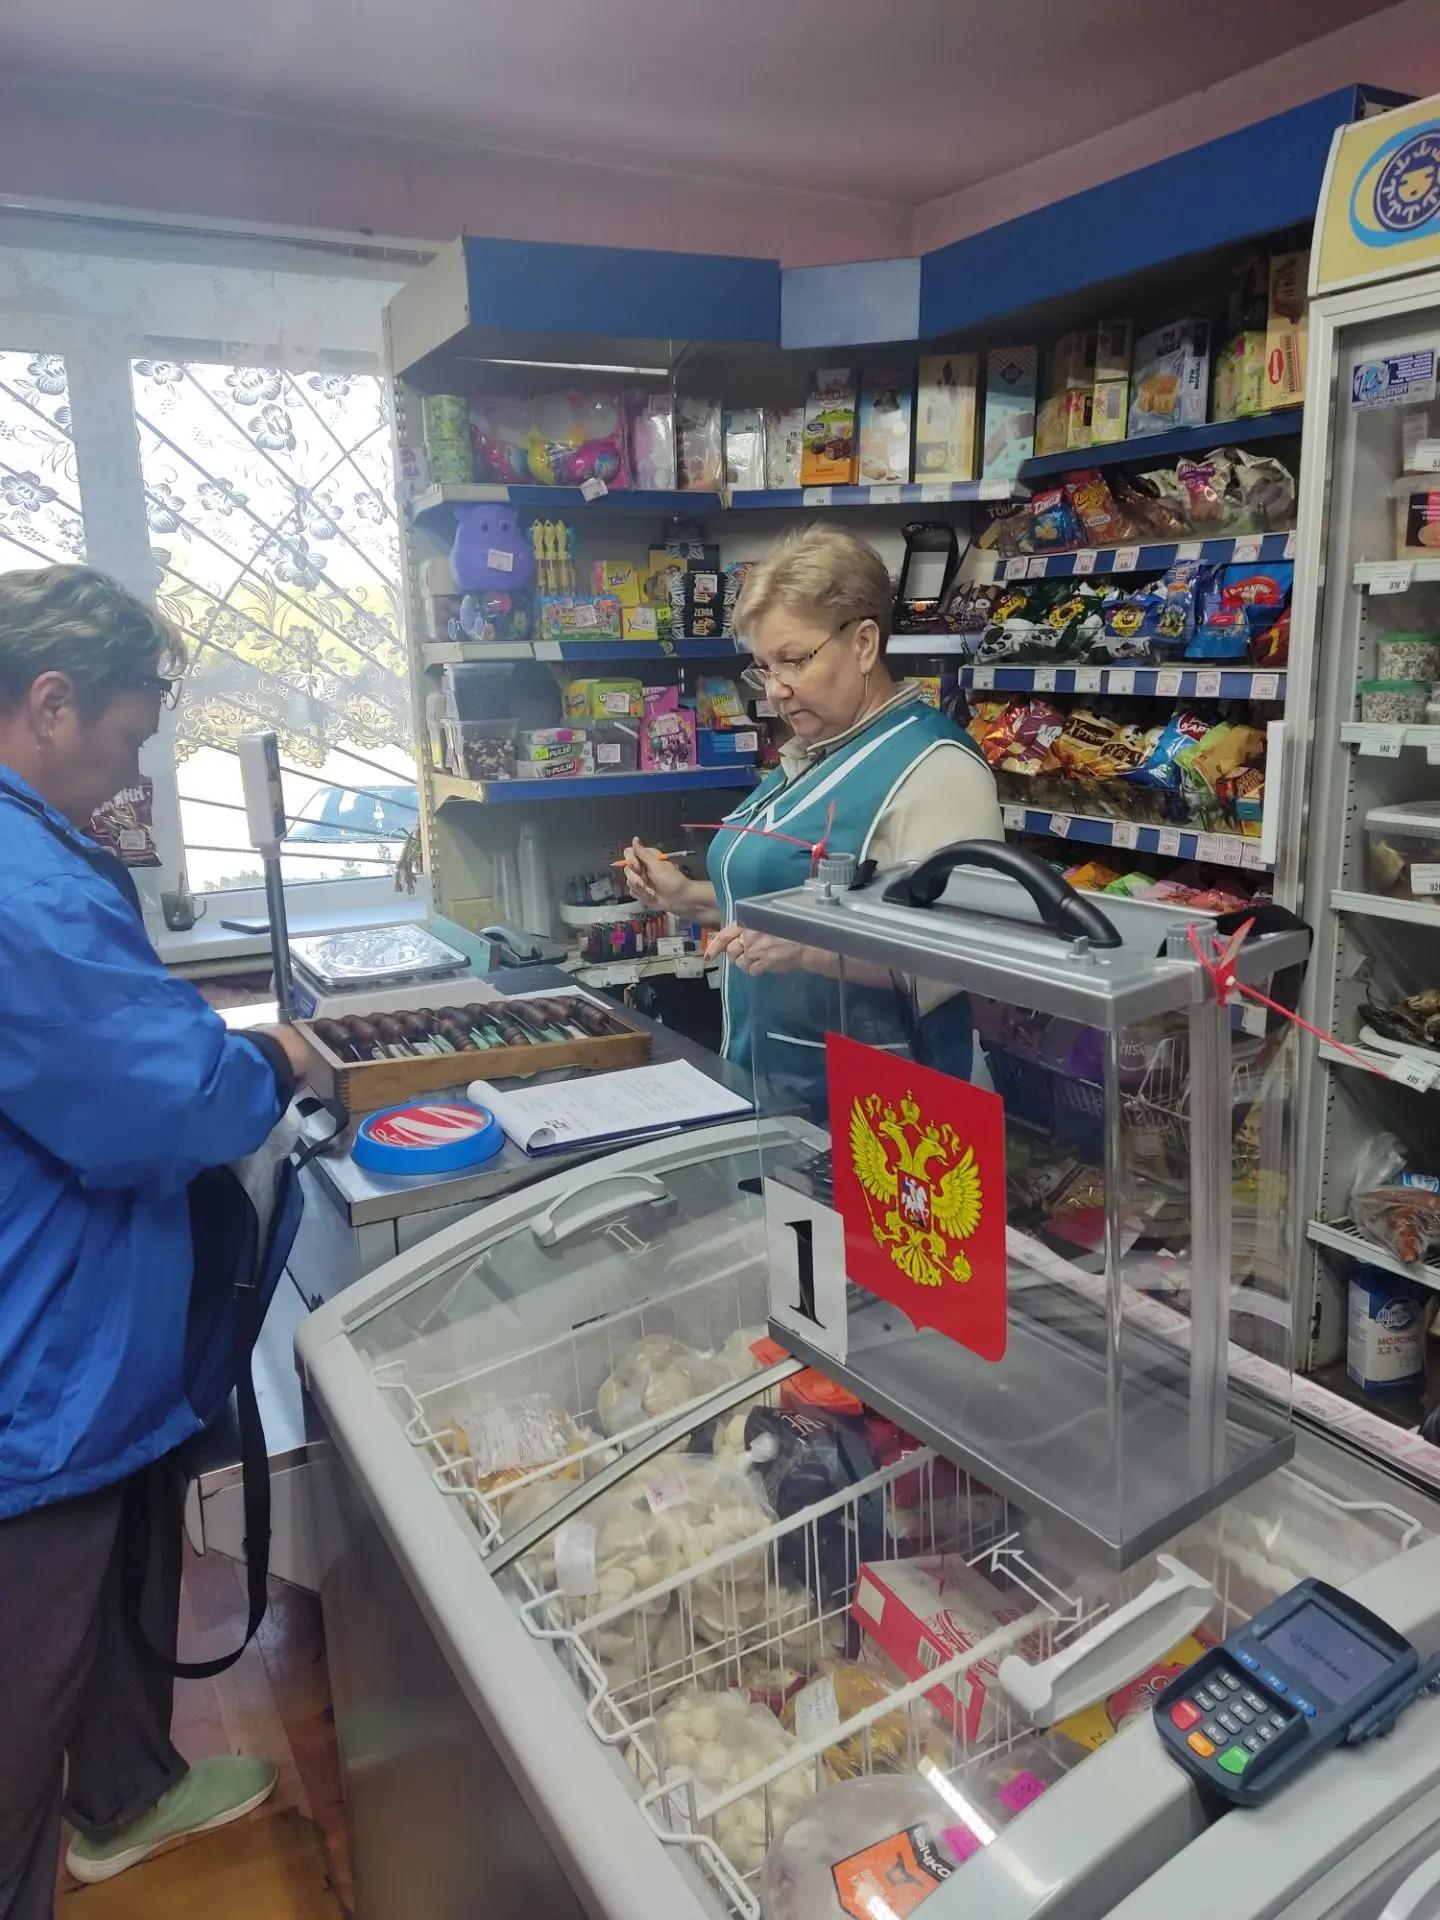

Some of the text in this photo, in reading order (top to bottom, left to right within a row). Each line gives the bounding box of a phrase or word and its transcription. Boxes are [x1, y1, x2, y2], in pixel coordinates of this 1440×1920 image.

[693, 607, 714, 617] ZEBRA
[784, 1219, 827, 1330] 1
[1242, 1653, 1253, 1665] F1
[1269, 1676, 1281, 1687] F2
